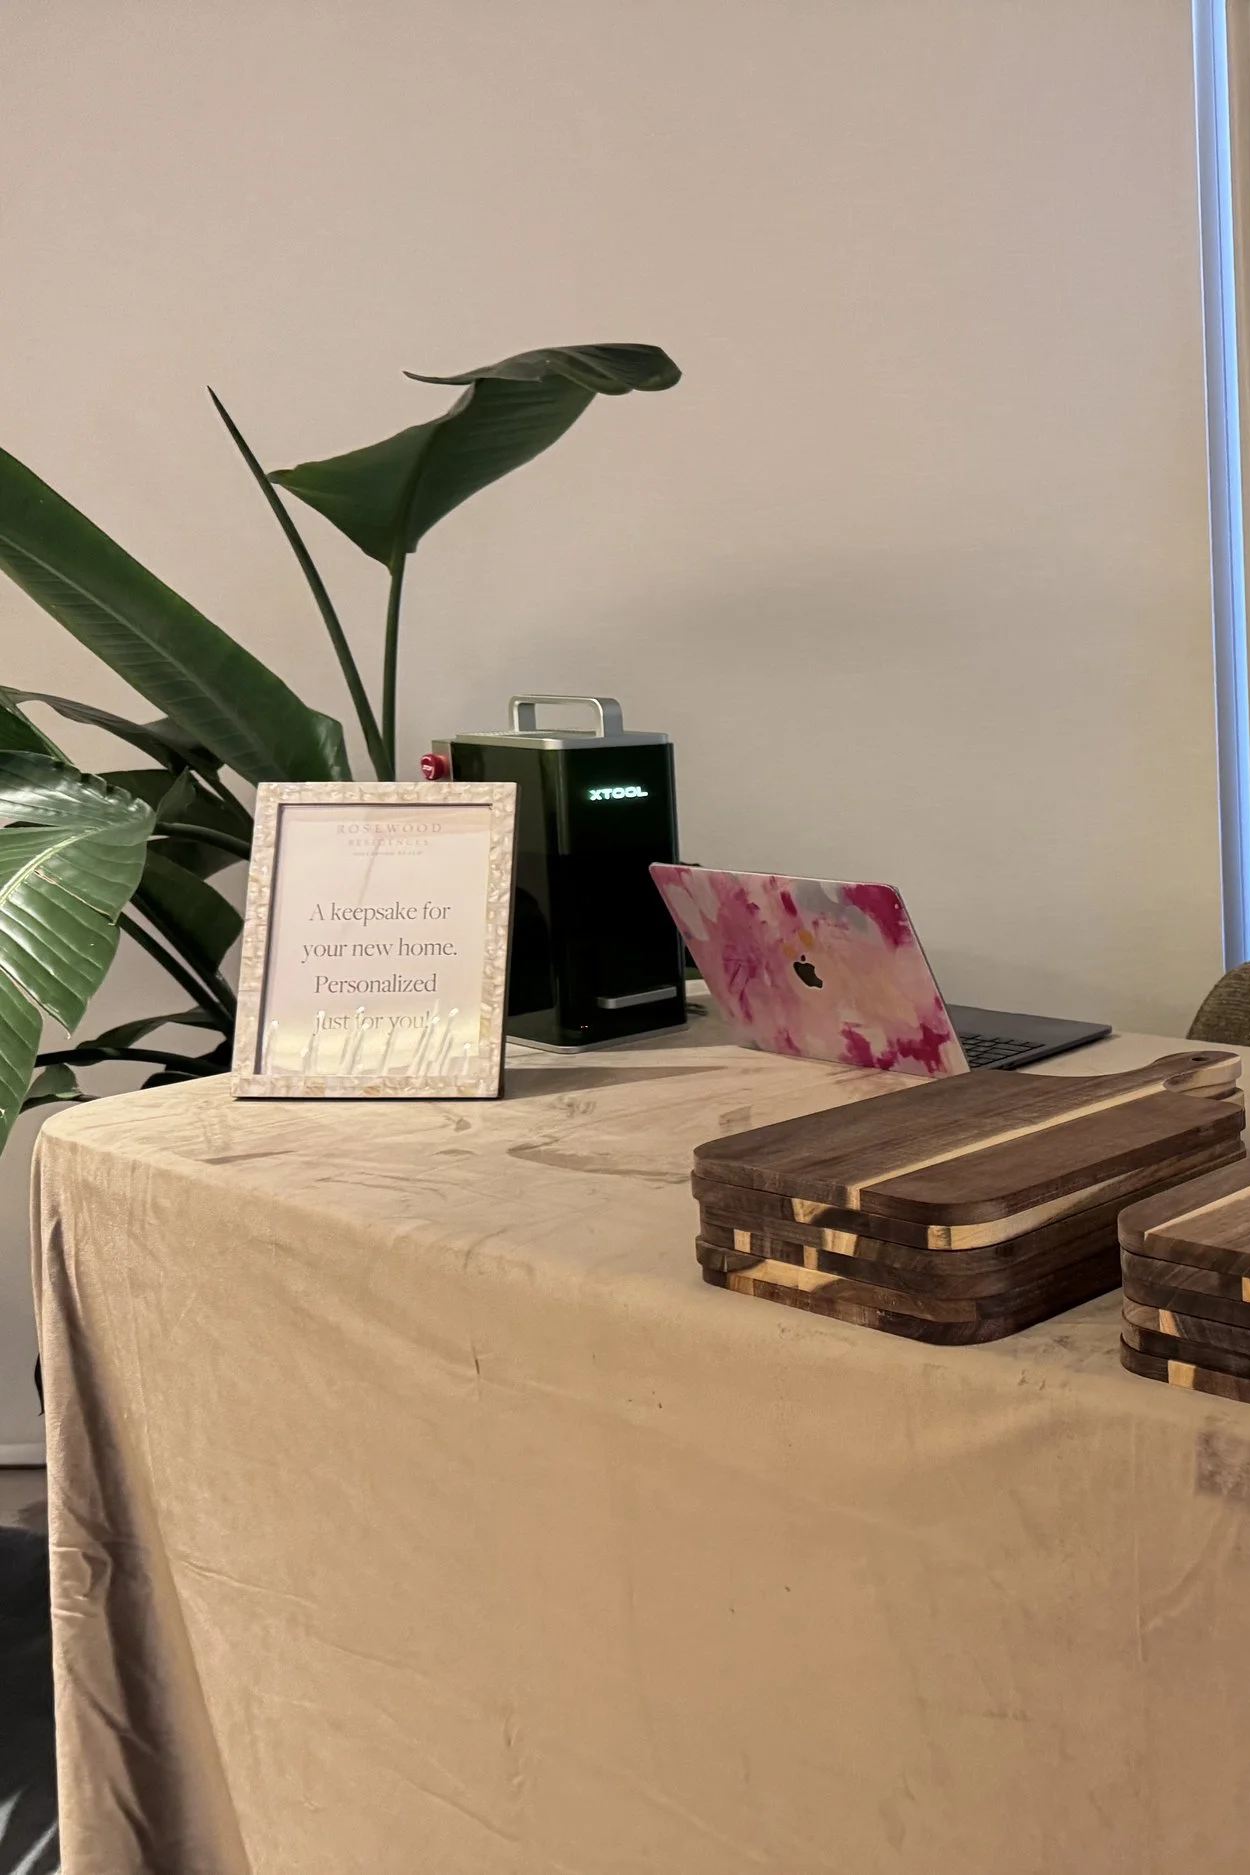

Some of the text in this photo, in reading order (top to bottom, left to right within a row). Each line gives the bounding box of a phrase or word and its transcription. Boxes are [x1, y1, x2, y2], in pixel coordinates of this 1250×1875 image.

[336, 823, 442, 834] ROSEWOOD
[308, 901, 451, 926] A keepsake for
[301, 938, 458, 963] your new home.
[314, 973, 438, 994] Personalized
[313, 1010, 430, 1036] just for you!
